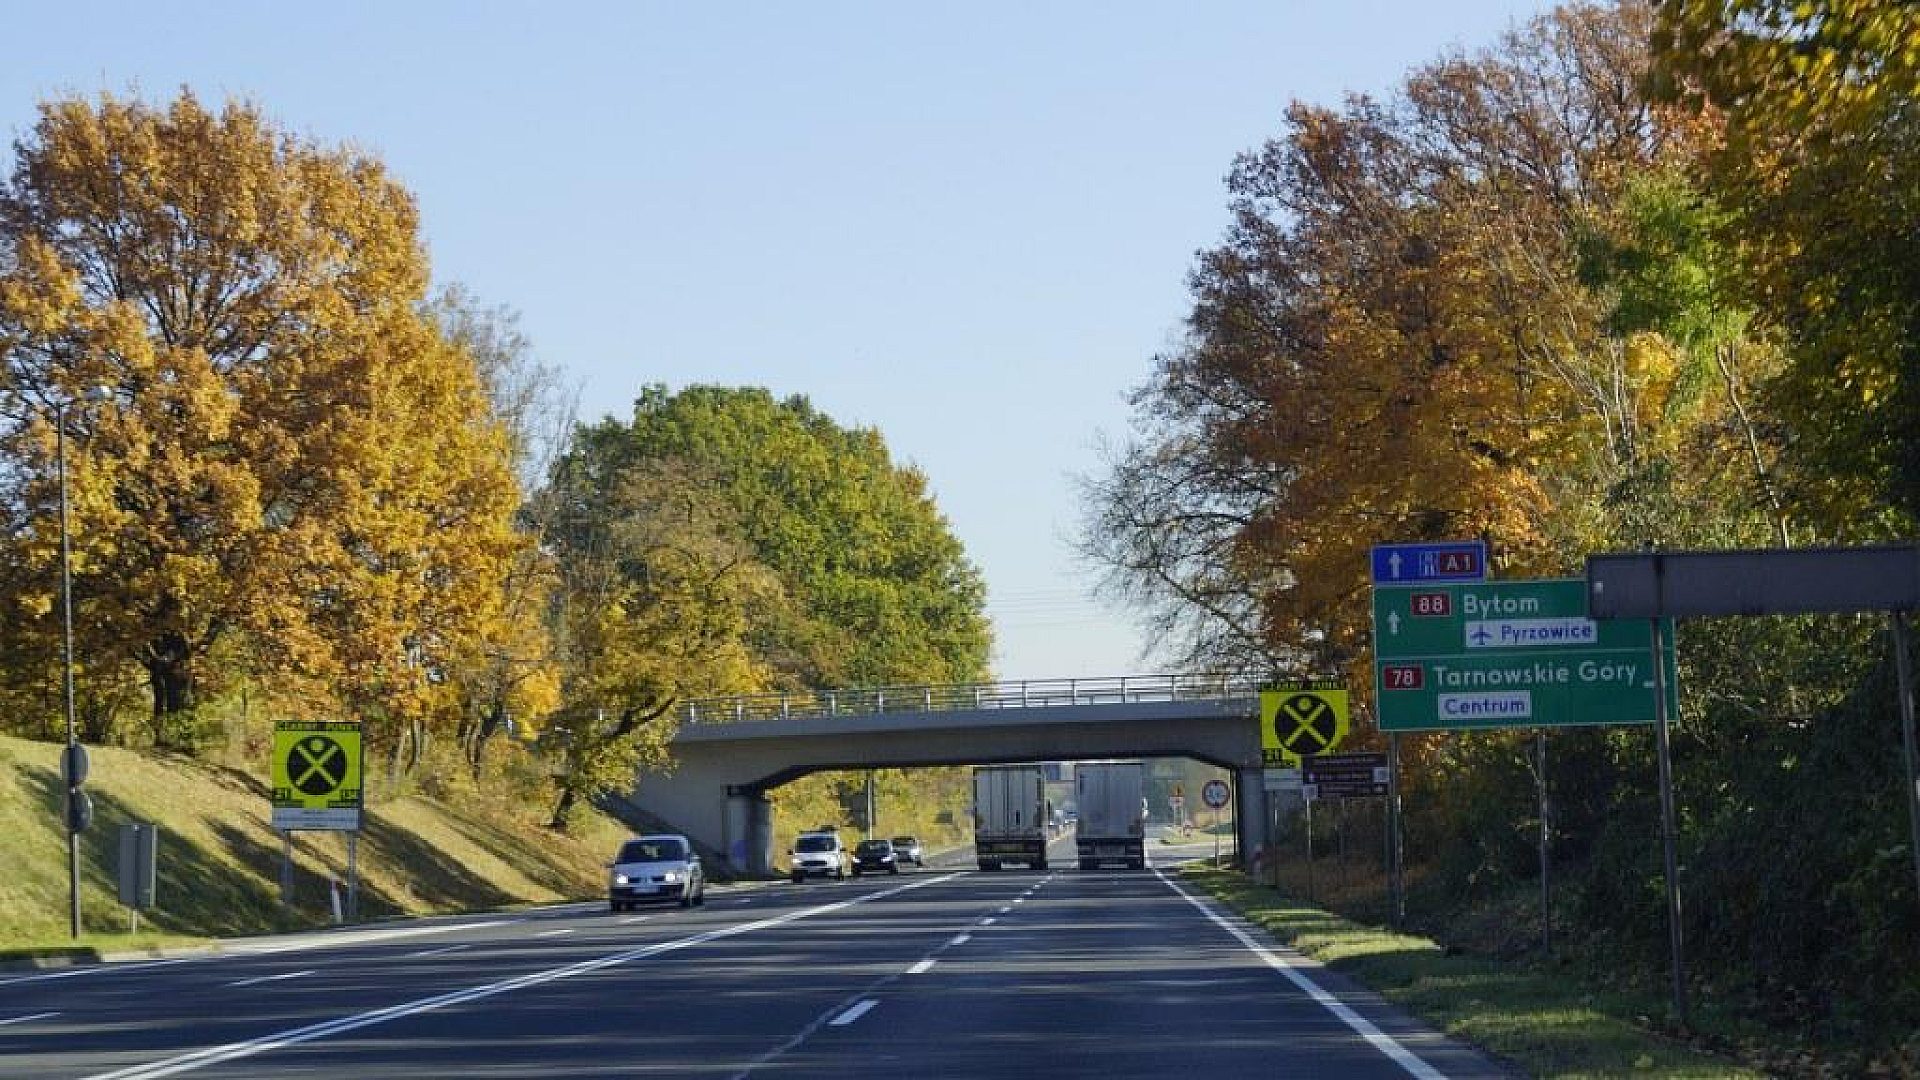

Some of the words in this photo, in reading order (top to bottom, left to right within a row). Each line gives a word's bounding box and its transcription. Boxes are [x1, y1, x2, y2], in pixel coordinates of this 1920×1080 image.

[1446, 553, 1472, 572] A1
[1418, 596, 1443, 613] 88
[1463, 594, 1539, 618] Bytom
[1500, 624, 1593, 644] Pyrzowice
[1391, 669, 1414, 687] 78
[1433, 662, 1571, 687] Tarnowskie
[1578, 659, 1637, 687] Góry
[1444, 697, 1526, 716] Centrum
